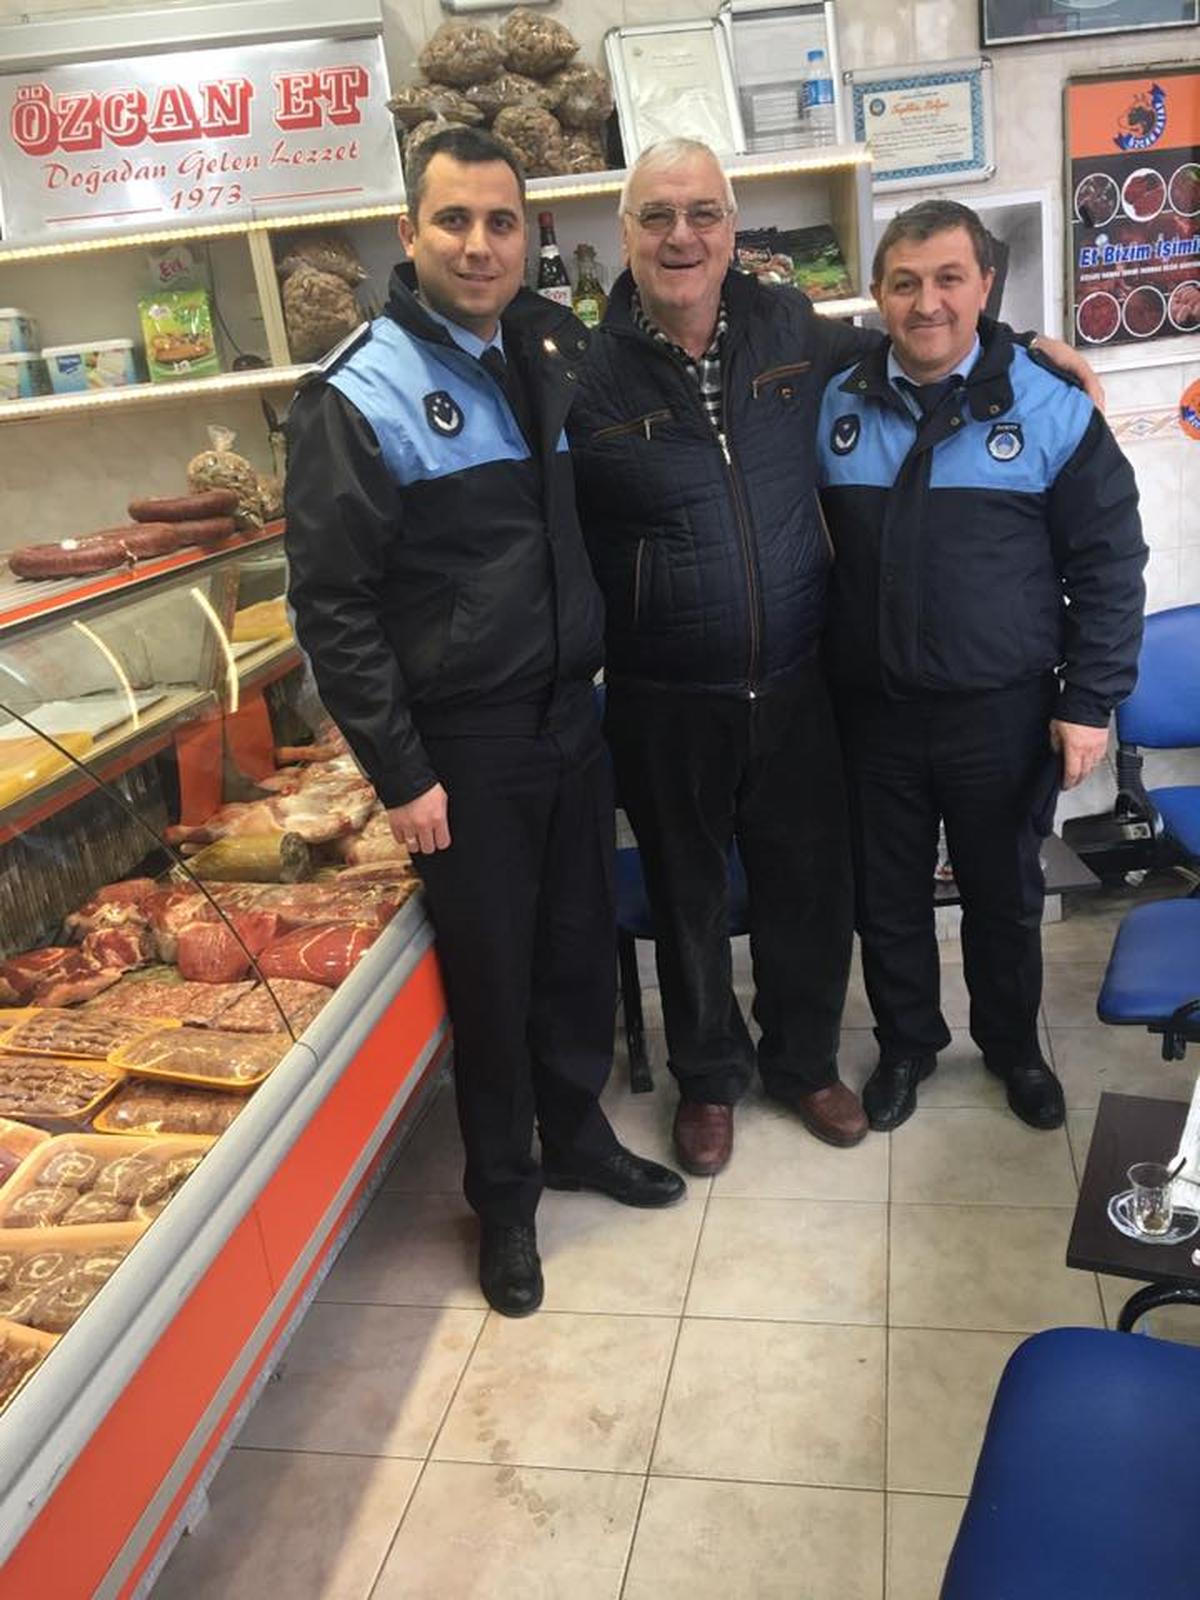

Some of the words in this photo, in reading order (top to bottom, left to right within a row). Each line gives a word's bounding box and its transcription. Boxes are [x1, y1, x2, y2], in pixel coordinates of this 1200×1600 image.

[11, 78, 254, 156] ÖZCAN
[274, 66, 370, 131] ET
[45, 160, 167, 194] Doğadan
[179, 150, 261, 181] Gelen
[269, 140, 360, 166] Lezzet
[171, 185, 243, 211] 1973
[1079, 247, 1099, 268] Et
[1103, 242, 1153, 265] Bizim
[1154, 234, 1200, 262] İşimi
